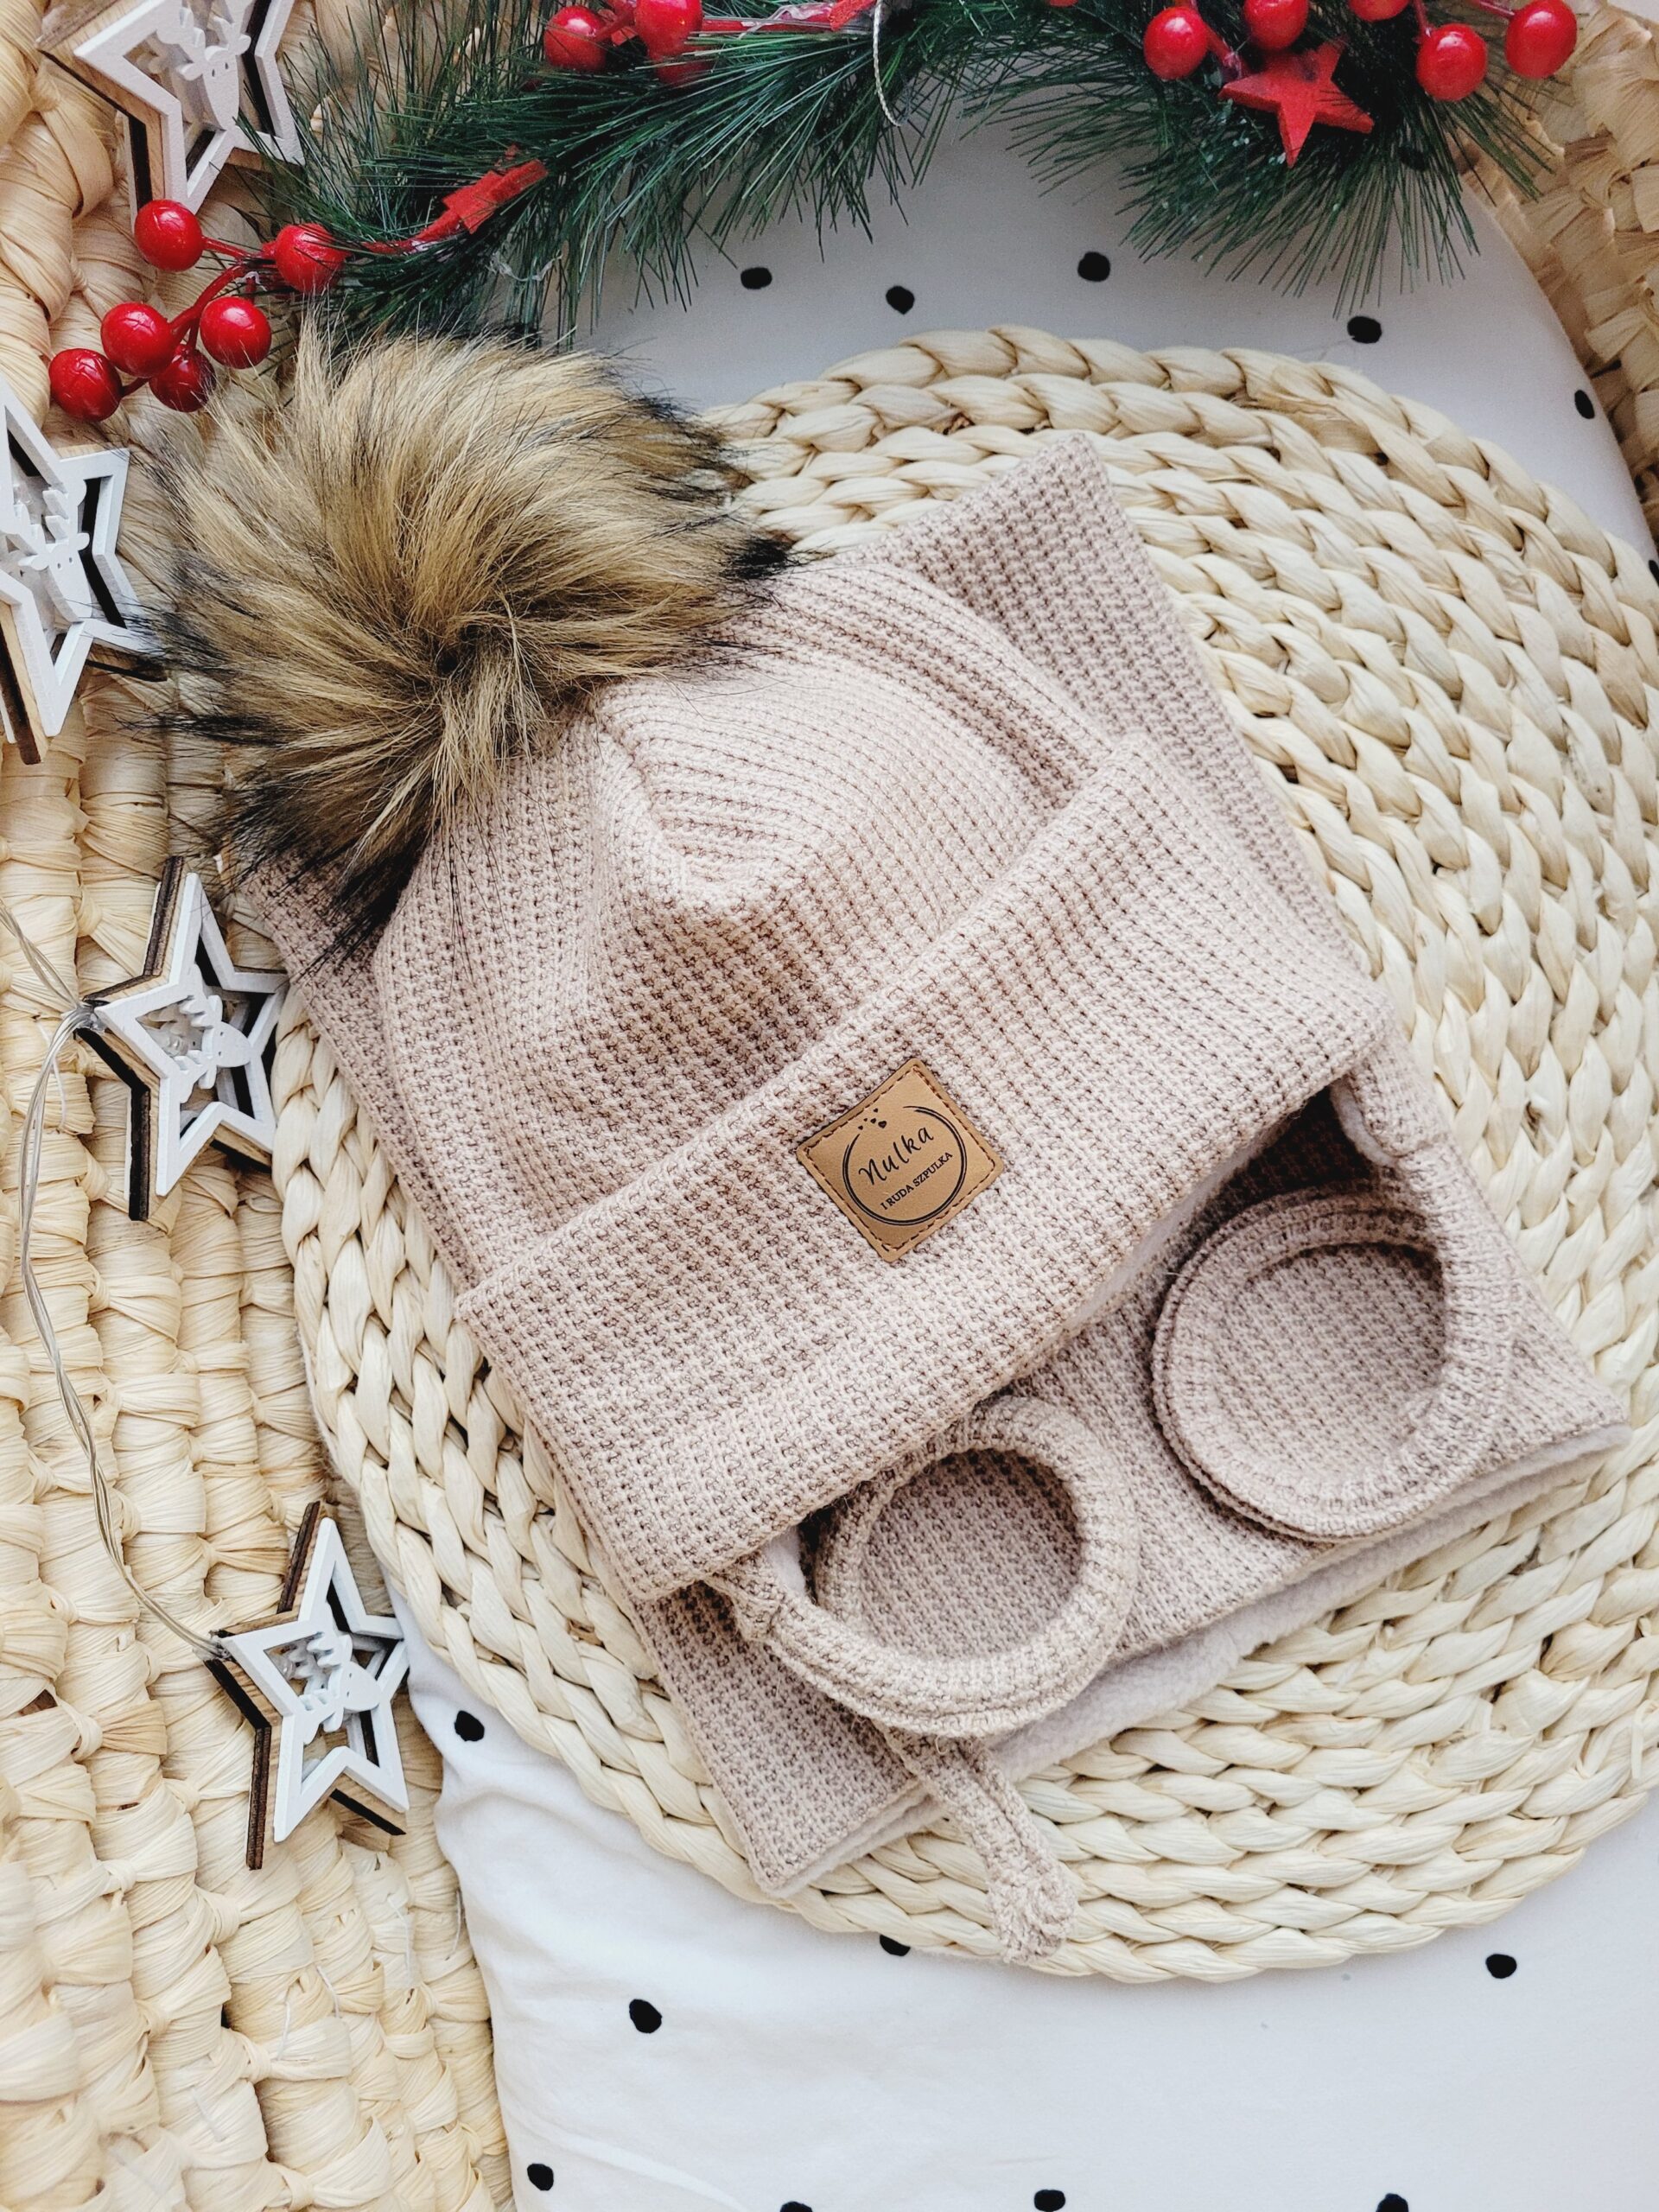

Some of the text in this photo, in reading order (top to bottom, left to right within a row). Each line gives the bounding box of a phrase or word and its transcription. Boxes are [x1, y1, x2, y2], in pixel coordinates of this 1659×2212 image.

[858, 1127, 934, 1185] Nulka
[886, 1185, 914, 1207] RUDA
[912, 1152, 953, 1187] SZPULKA
